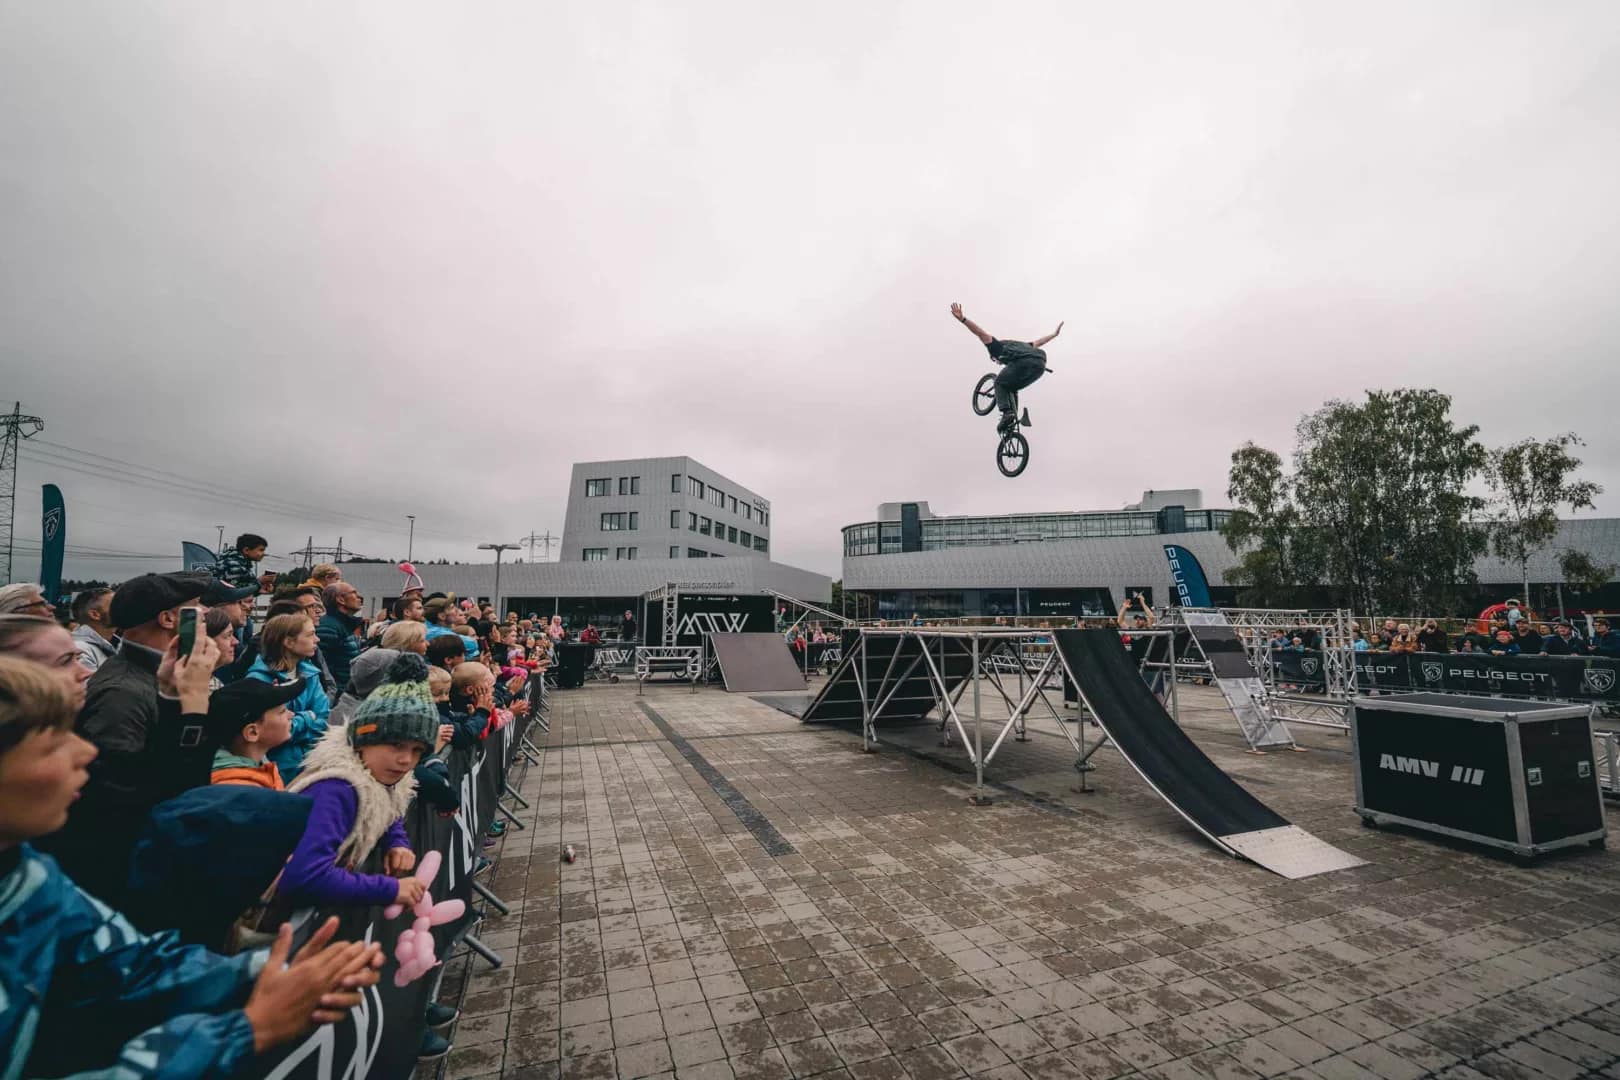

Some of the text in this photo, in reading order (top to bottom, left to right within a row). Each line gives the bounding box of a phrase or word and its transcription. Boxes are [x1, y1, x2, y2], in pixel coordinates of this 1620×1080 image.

[1165, 547, 1192, 607] PEUGE
[1449, 668, 1549, 682] PEUGEOT
[1380, 753, 1439, 778] AMV
